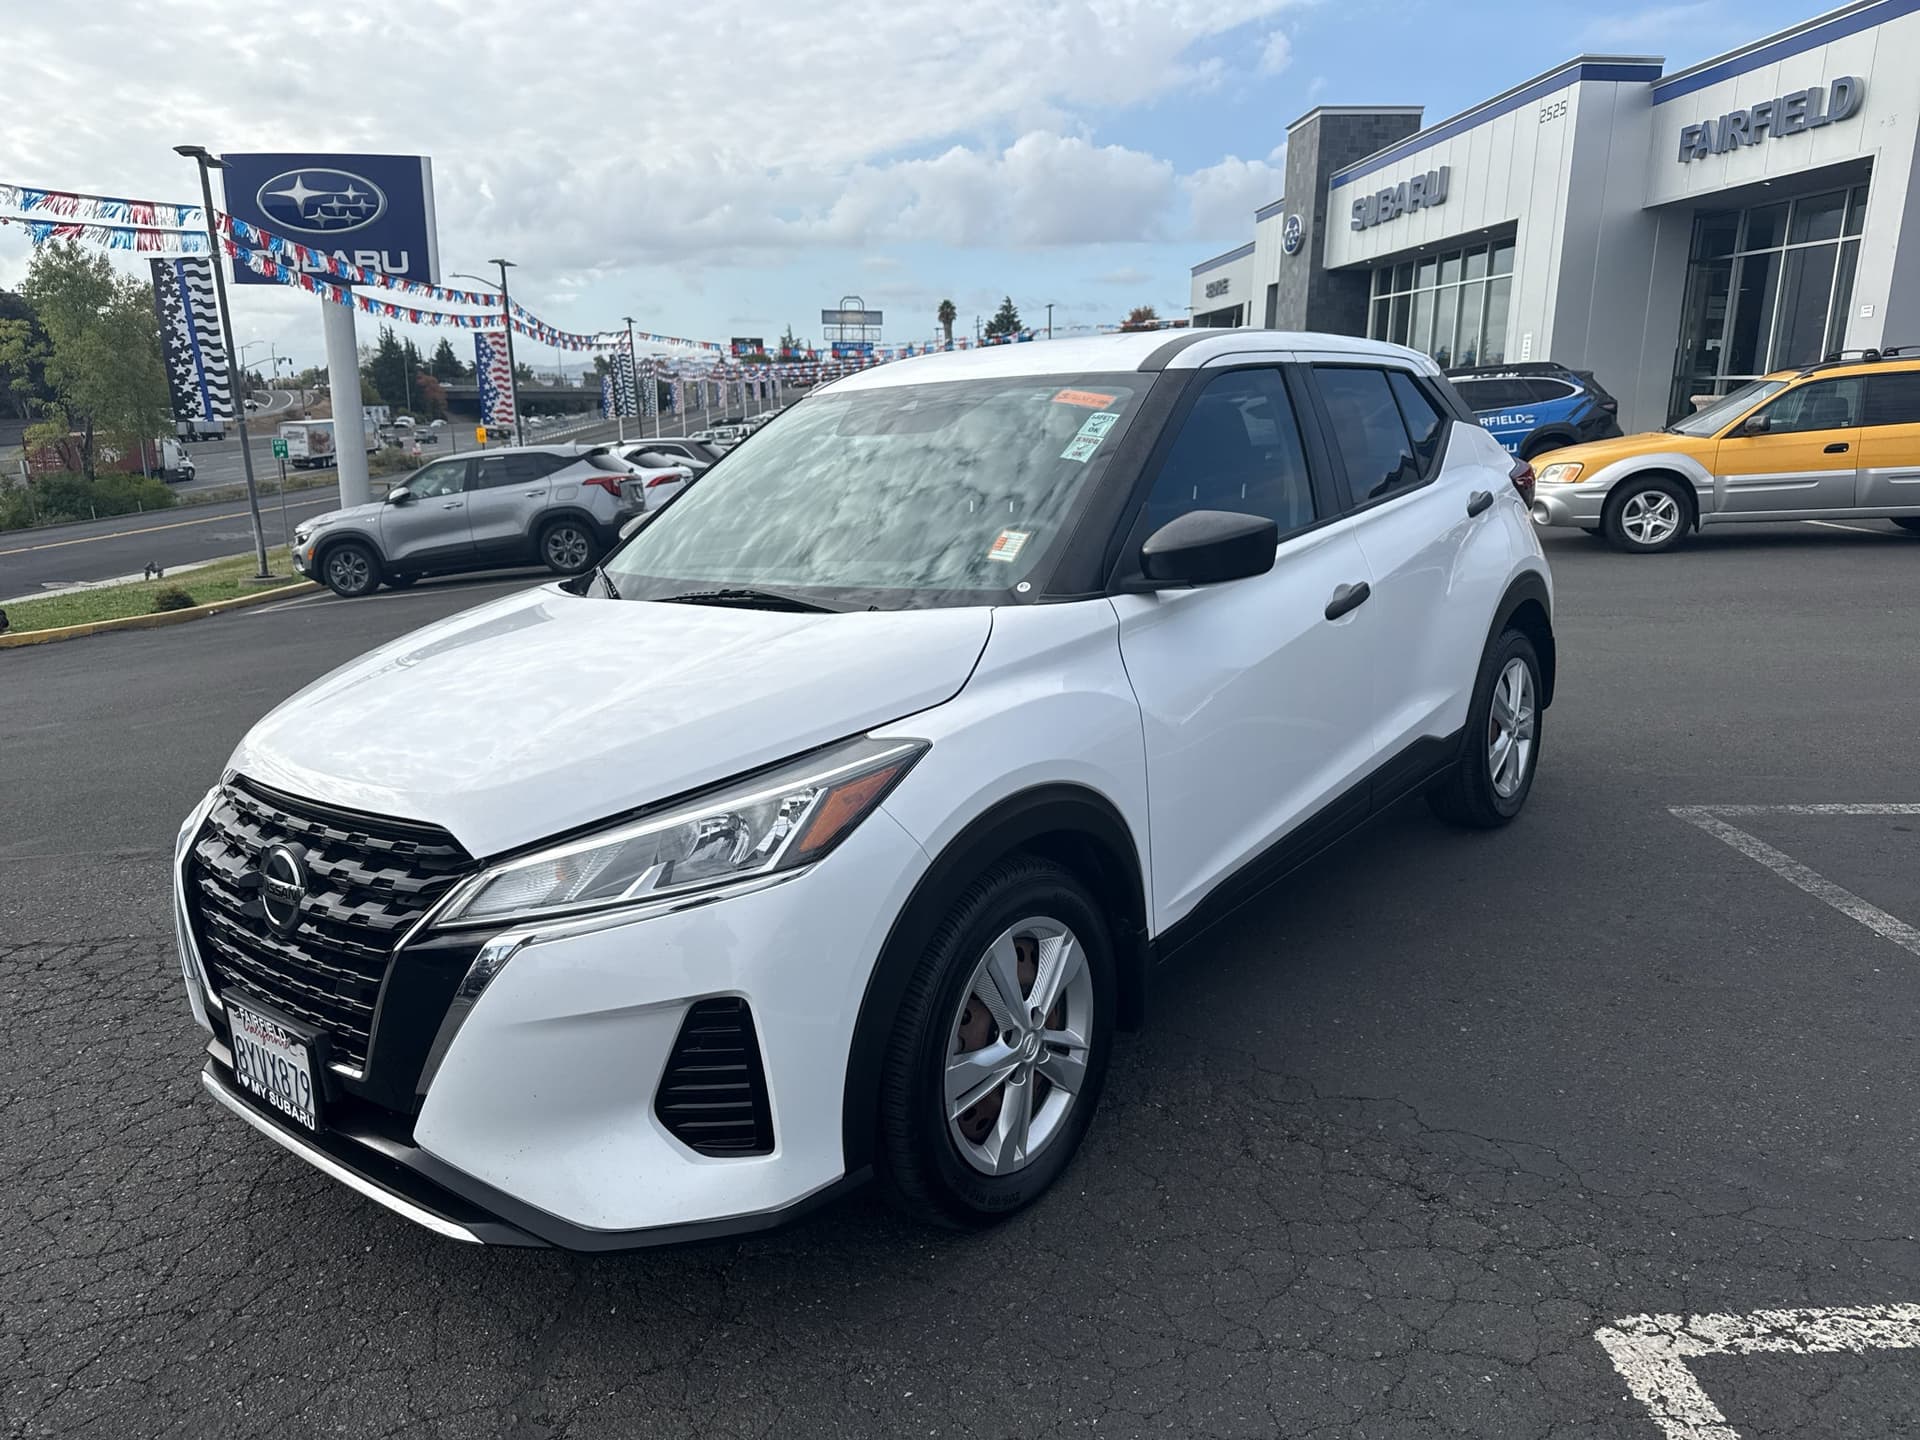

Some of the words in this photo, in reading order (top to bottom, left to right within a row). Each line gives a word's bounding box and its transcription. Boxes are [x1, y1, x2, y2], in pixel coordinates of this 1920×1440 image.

[1540, 100, 1567, 123] 2525
[1678, 76, 1864, 163] FAIRFIELD
[1351, 166, 1451, 231] SUBARU
[1480, 414, 1525, 426] RFIELD
[236, 1035, 310, 1111] 8YVX879
[251, 1080, 267, 1099] MY
[268, 1091, 315, 1131] SUBARU
